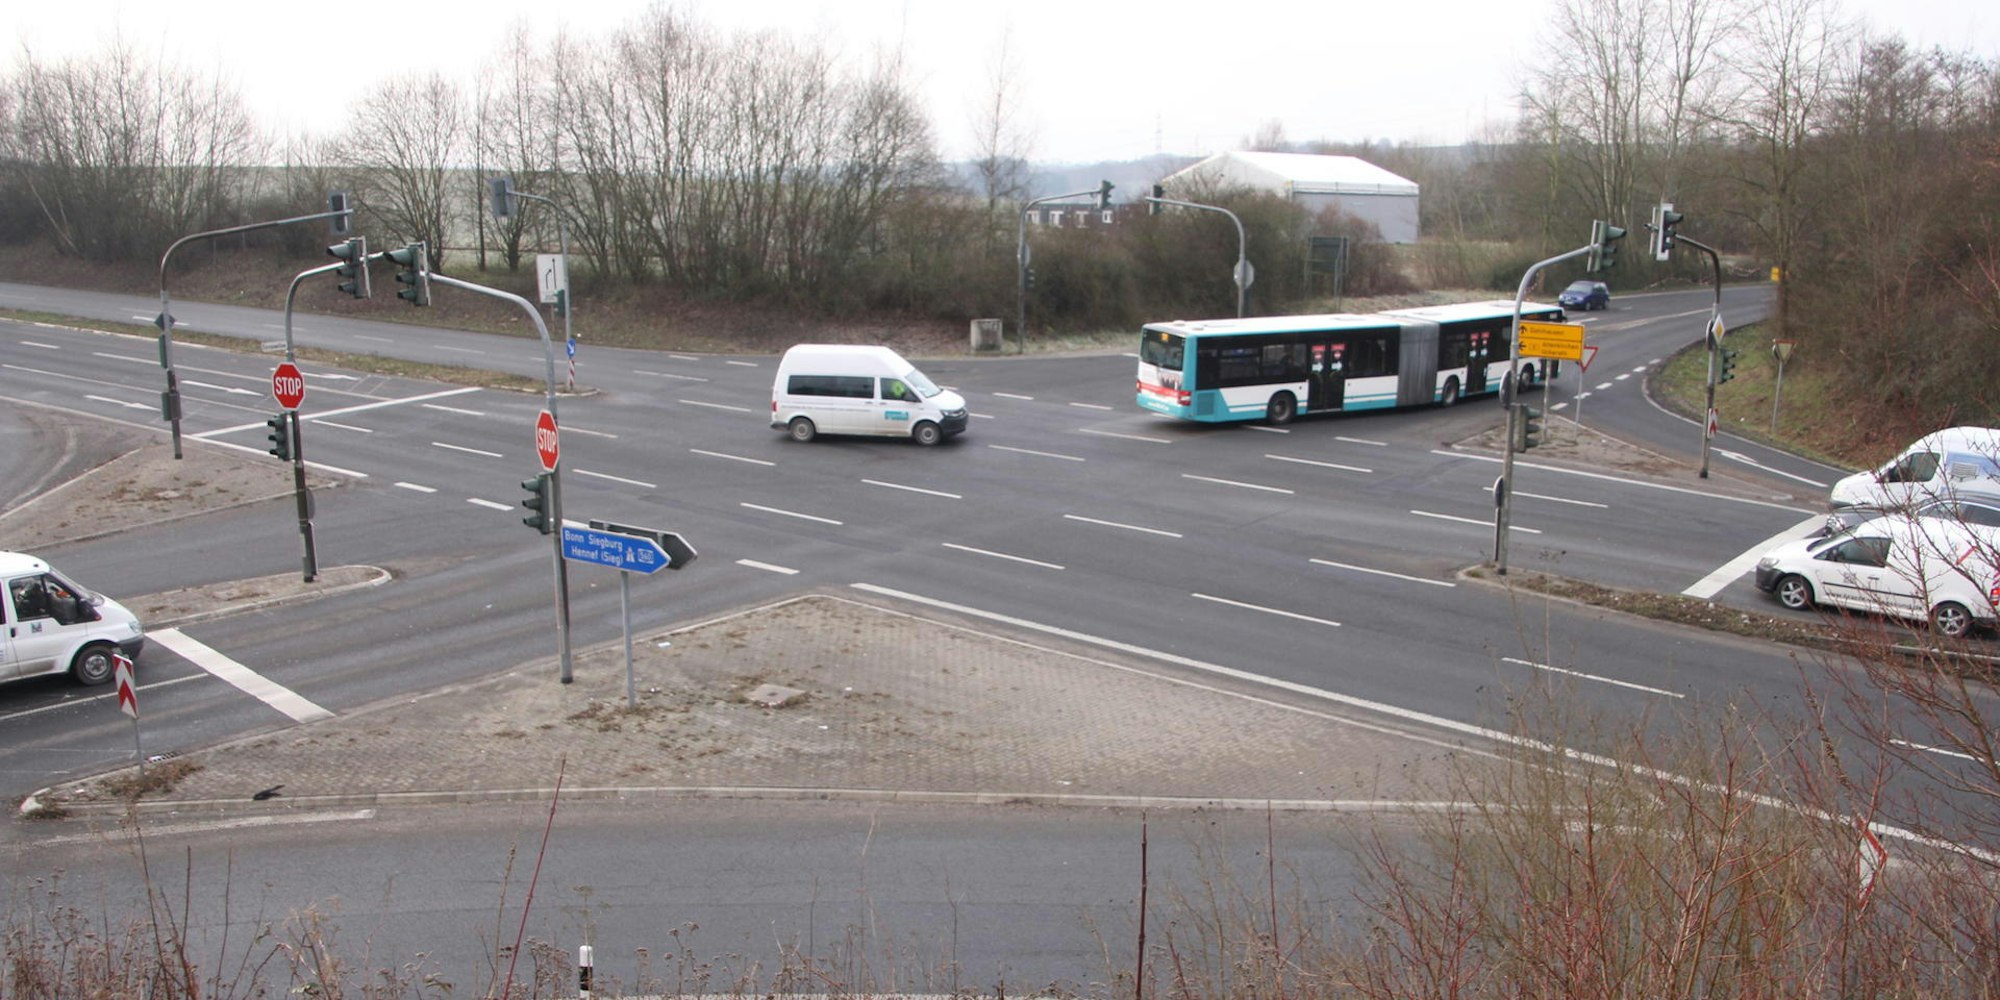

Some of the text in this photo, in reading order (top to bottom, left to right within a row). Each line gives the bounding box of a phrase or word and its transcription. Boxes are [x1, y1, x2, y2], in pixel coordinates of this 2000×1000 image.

[275, 376, 302, 396] STOP
[538, 427, 557, 454] STOP
[564, 529, 623, 552] Bonn Siegburg
[571, 545, 624, 566] Hennef (Sieg)
